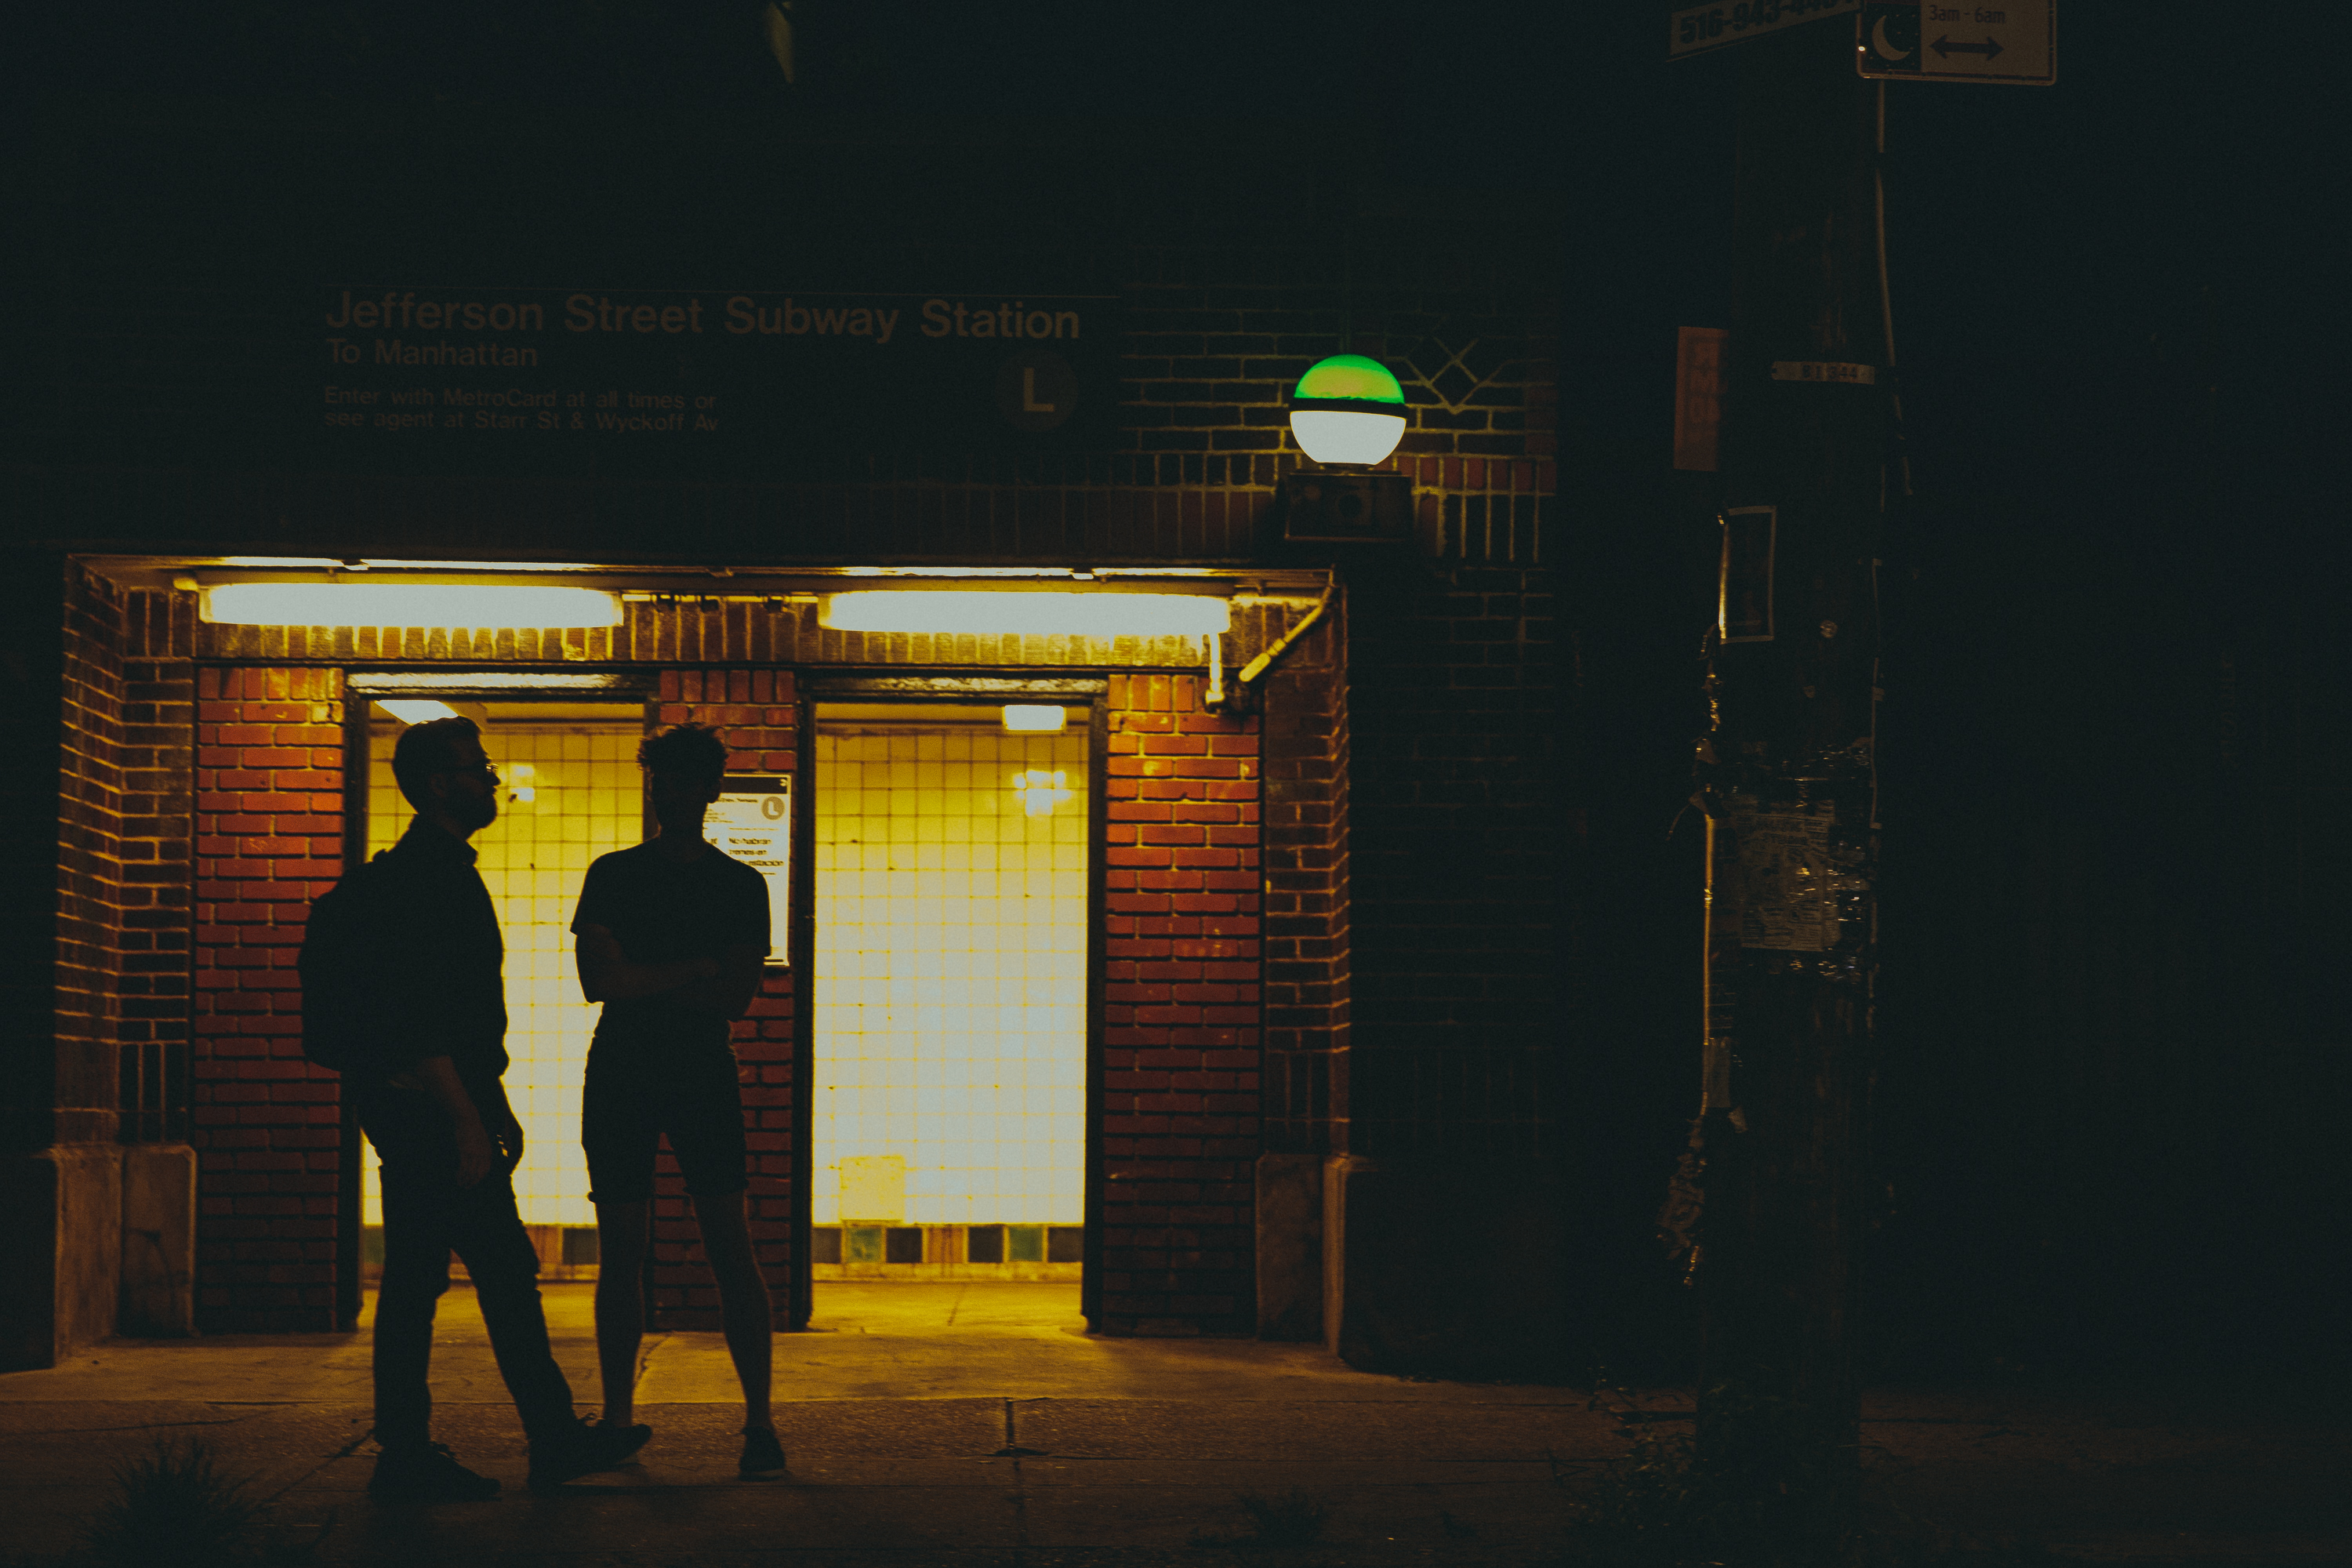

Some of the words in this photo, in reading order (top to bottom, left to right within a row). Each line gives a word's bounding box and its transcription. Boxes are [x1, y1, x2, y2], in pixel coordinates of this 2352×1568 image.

[1930, 5, 1960, 21] 3am
[1975, 7, 2005, 24] 6am
[326, 291, 543, 330] Jefferson
[565, 294, 702, 333] Street
[726, 296, 898, 343] Subway
[921, 299, 1079, 338] Station
[327, 338, 360, 363] To
[376, 339, 537, 366] Manhattan
[325, 386, 379, 404] Enter
[391, 388, 434, 405] with
[444, 388, 556, 407] MetroCard
[566, 392, 585, 407] at
[597, 391, 618, 408] all
[628, 393, 684, 408] times
[695, 396, 716, 409] or
[1024, 368, 1055, 412] L
[325, 413, 364, 426] see
[374, 412, 434, 430] agent
[445, 412, 463, 427] at
[475, 410, 526, 428] Starr
[538, 411, 559, 429] St
[571, 412, 583, 429] &
[596, 413, 684, 433] Wyckoff
[695, 414, 717, 430] Av
[768, 800, 779, 816] L
